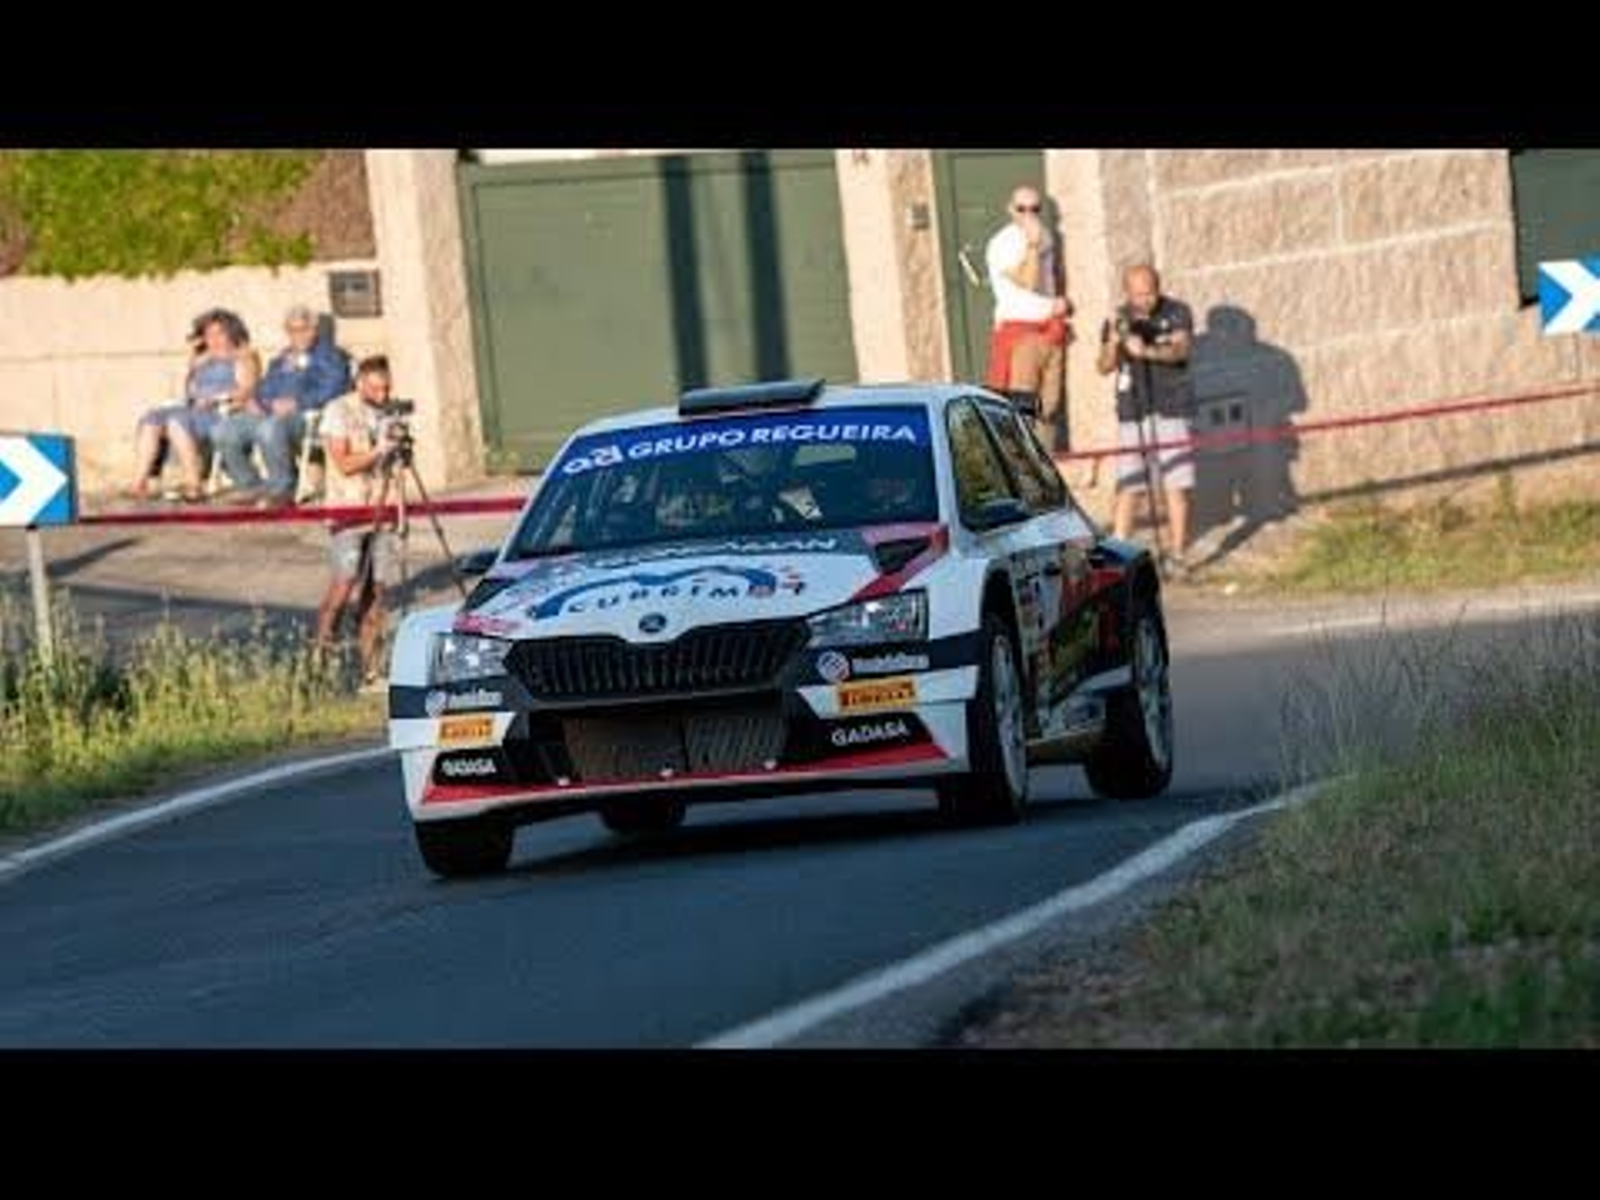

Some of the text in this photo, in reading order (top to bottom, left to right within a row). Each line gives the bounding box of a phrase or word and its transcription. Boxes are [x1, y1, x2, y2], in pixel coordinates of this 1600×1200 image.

[627, 429, 746, 460] GRUPO
[751, 423, 917, 444] REGUEIRA
[831, 720, 909, 747] GADASA
